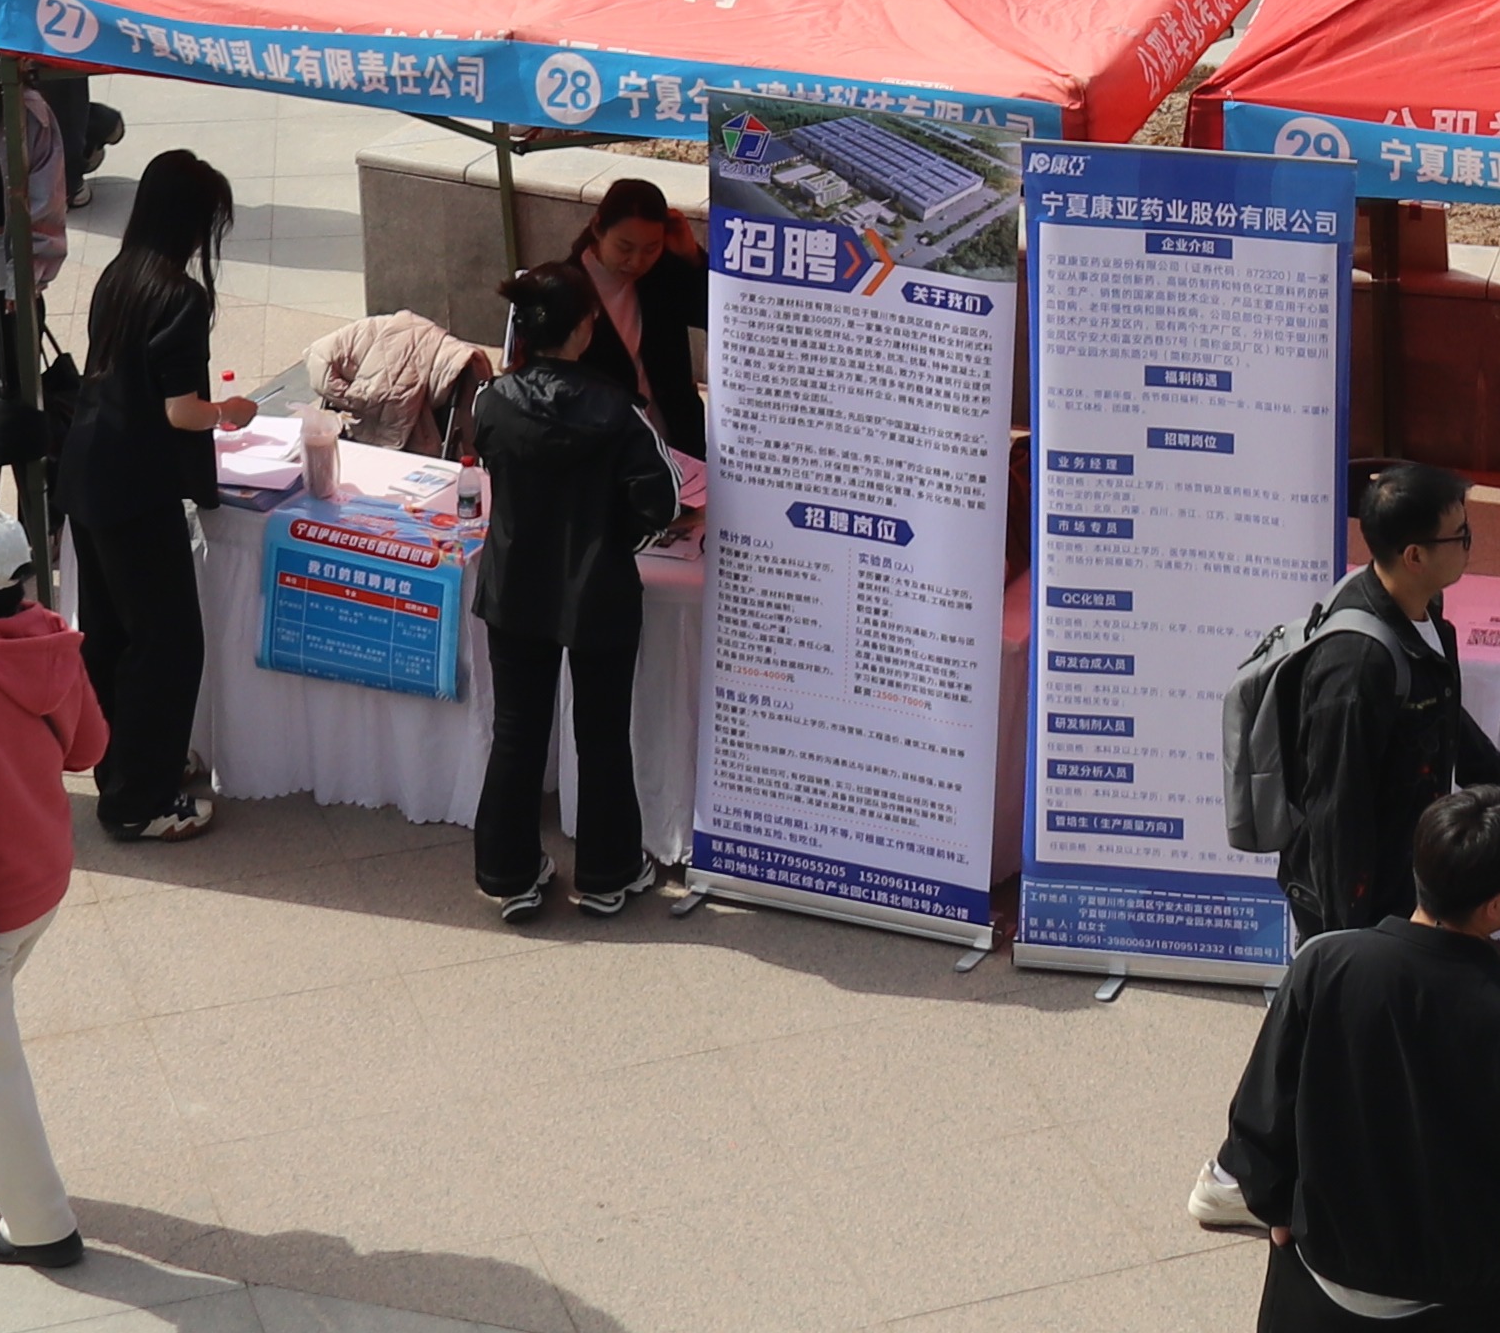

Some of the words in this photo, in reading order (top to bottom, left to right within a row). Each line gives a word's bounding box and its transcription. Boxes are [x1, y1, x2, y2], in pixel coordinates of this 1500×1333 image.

[117, 17, 486, 104] 宁夏伊利乳业有限责任公司
[546, 65, 592, 111] 28
[1041, 192, 1337, 236] 宁夏康亚药业股份有限公司
[723, 217, 838, 284] 招聘
[1161, 237, 1215, 254] 企业介绍
[912, 284, 982, 314] 关于我们
[1164, 370, 1218, 387] 福利待遇
[1164, 432, 1217, 449] 招聘岗位
[804, 506, 897, 542] 招聘岗位
[1058, 520, 1117, 535] 市场专员
[296, 521, 435, 566] 宁夏伊利2026届校园招聘
[307, 559, 413, 595] 我们的招聘岗位
[1062, 592, 1116, 606] QC化验员
[1055, 655, 1126, 671] 研发合成人员
[1055, 717, 1126, 733] 研发制剂人员
[1056, 763, 1127, 779] 研发分析人员
[859, 870, 940, 896] 15209611487
